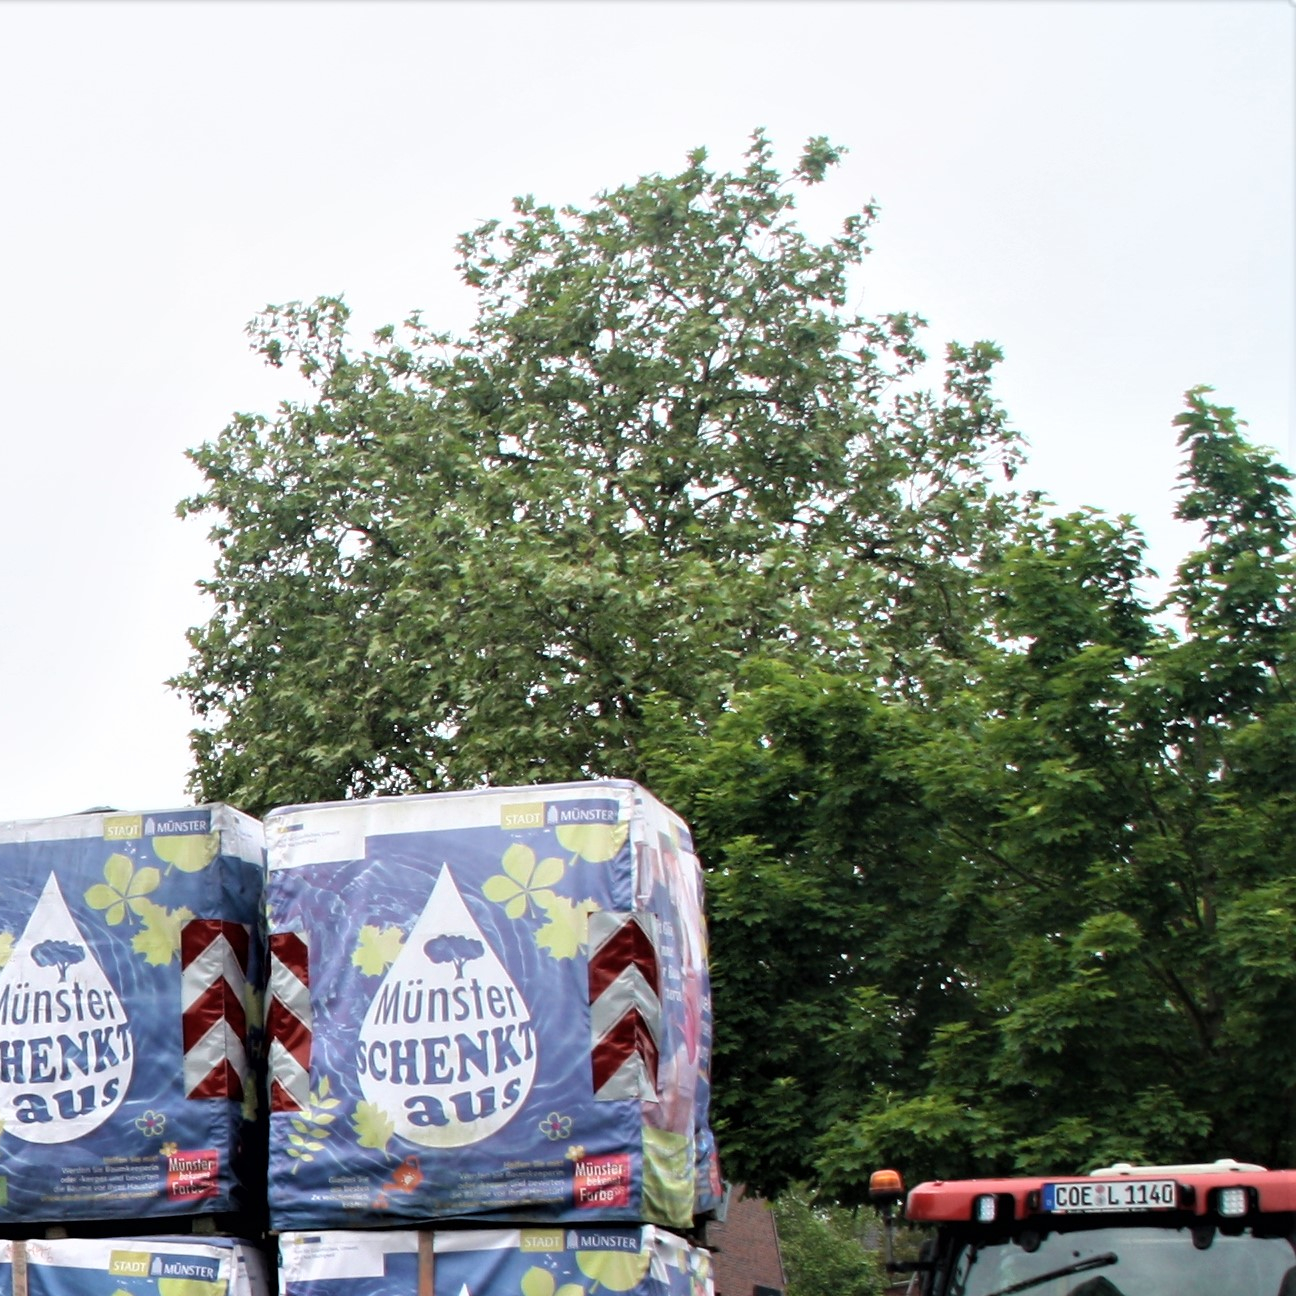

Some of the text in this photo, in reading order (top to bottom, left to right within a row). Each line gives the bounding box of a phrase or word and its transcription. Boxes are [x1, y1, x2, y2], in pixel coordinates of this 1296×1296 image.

[505, 807, 614, 826] STADT MÜNSTER
[108, 818, 207, 836] STADT MÜNSTER
[374, 978, 518, 1025] Münster
[357, 1019, 535, 1085] SCHENKT
[12, 1078, 119, 1123] aus
[403, 1077, 522, 1127] aus
[169, 1157, 214, 1172] Münster
[575, 1162, 623, 1177] Münster
[579, 1187, 615, 1201] Farbe
[1056, 1184, 1173, 1206] COE L 1140
[524, 1233, 637, 1249] STADT MÜNSTER
[113, 1260, 215, 1279] STADT MÜNSTER
